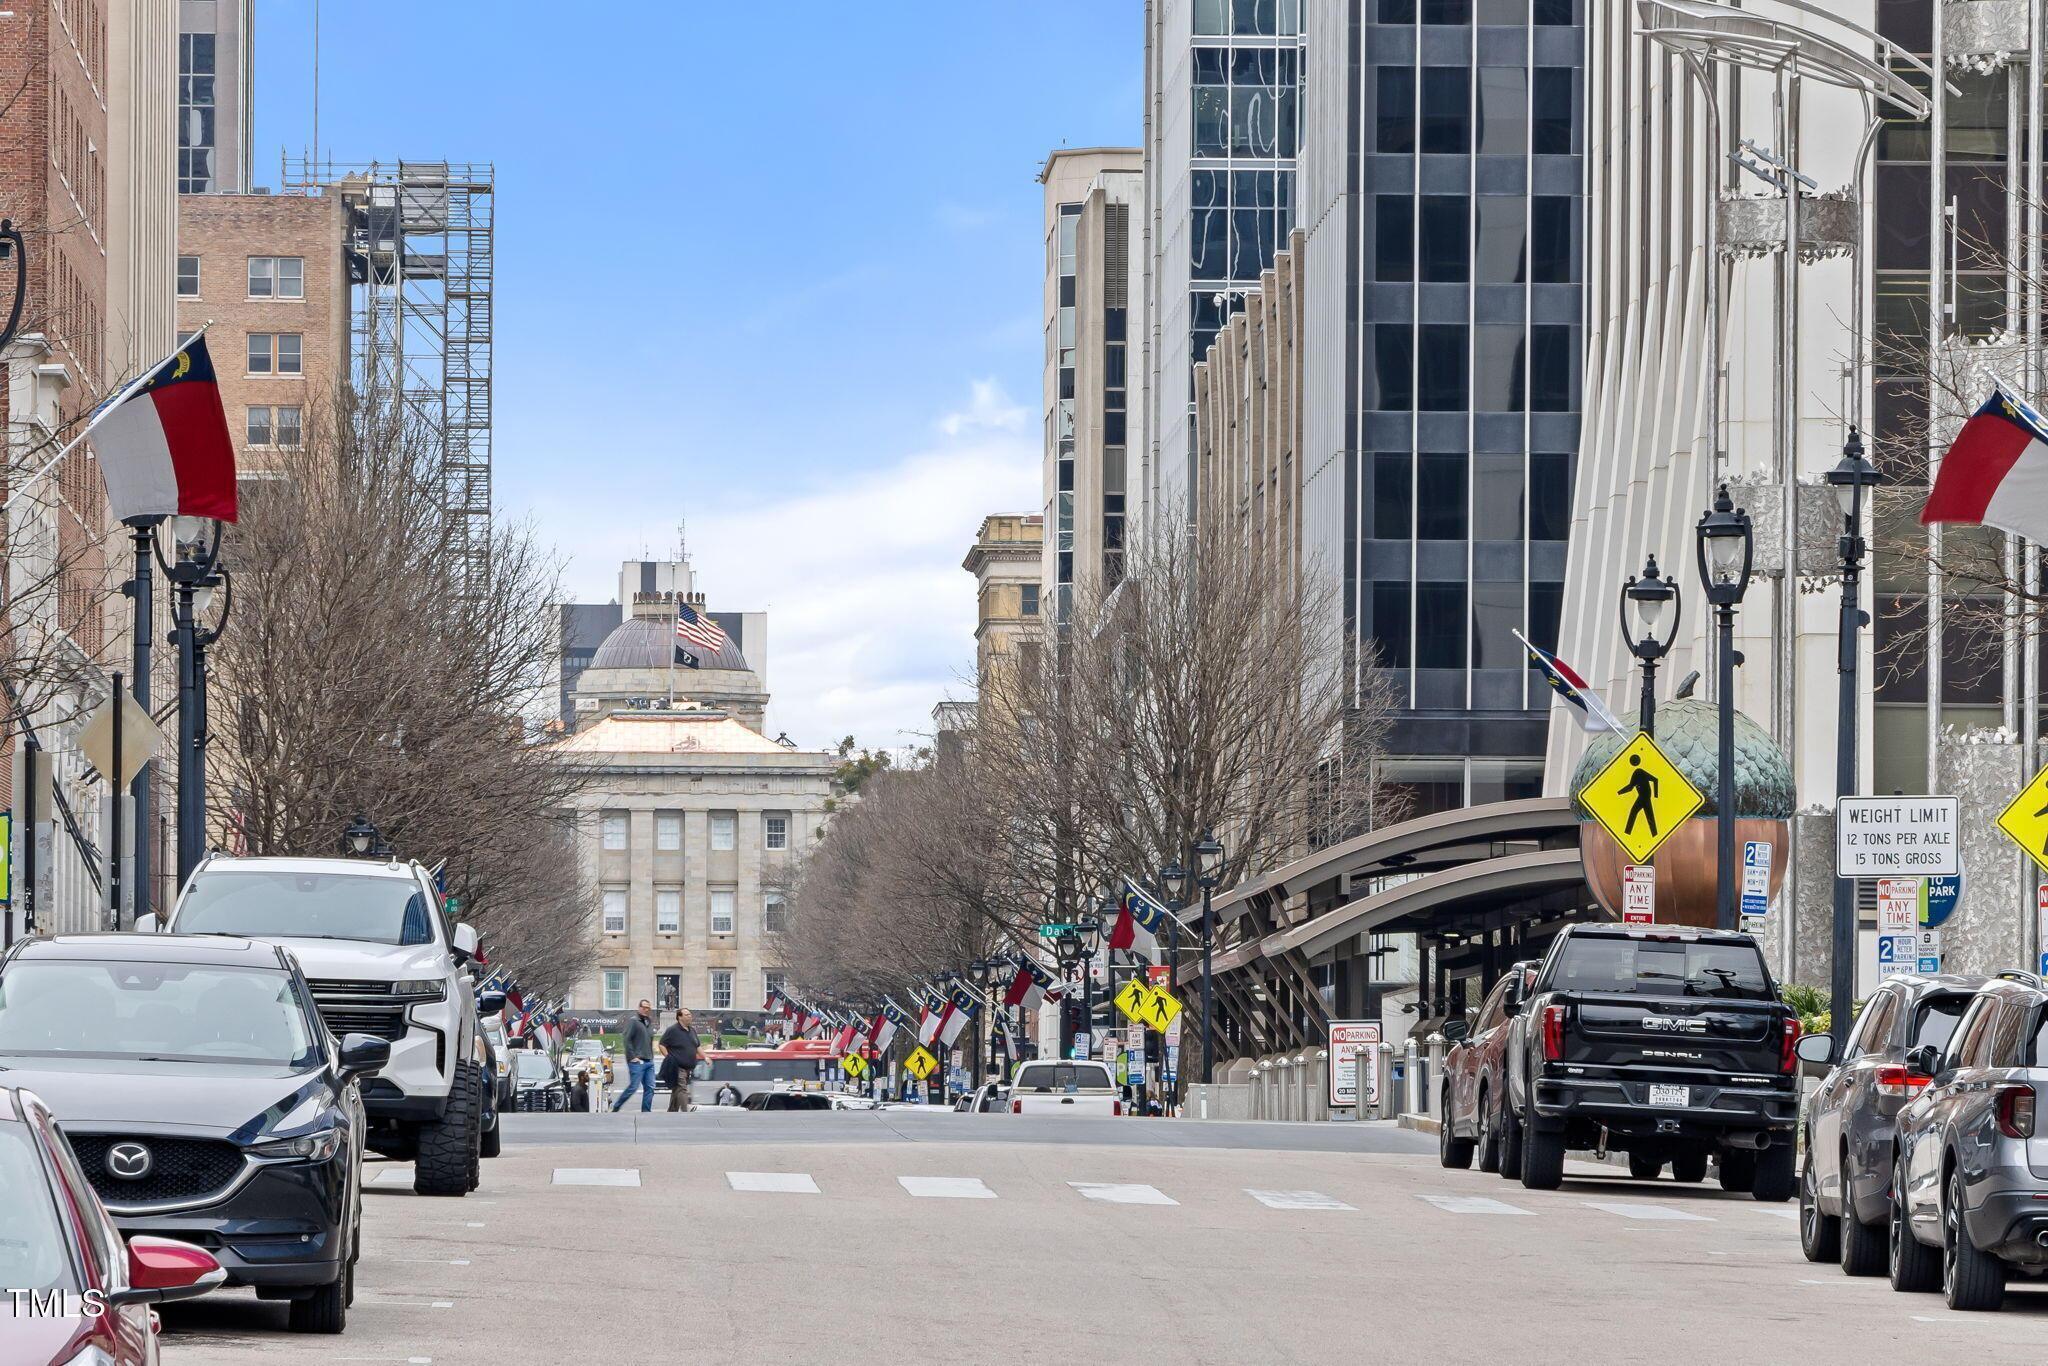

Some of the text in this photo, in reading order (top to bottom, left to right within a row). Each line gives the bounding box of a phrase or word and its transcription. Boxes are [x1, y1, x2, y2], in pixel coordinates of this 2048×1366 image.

[1849, 808, 1948, 823] WEIGHT LIMIT
[1847, 832, 1950, 845] 12 TONS PER AXLE
[1746, 846, 1755, 863] 2
[1855, 853, 1942, 865] 15 TONS GROSS
[1929, 876, 1943, 885] TO
[1629, 884, 1649, 894] ANY
[1880, 884, 1916, 896] NO PARKING
[1929, 886, 1956, 897] PARK
[1628, 894, 1650, 905] TIME
[2041, 890, 2048, 903] N
[1887, 900, 1909, 912] ANY
[1886, 912, 1911, 924] TIME
[1880, 940, 1892, 960] 2
[1642, 1017, 1707, 1033] GMC
[1333, 1030, 1376, 1040] NO PARKING
[1641, 1050, 1702, 1059] DENALI
